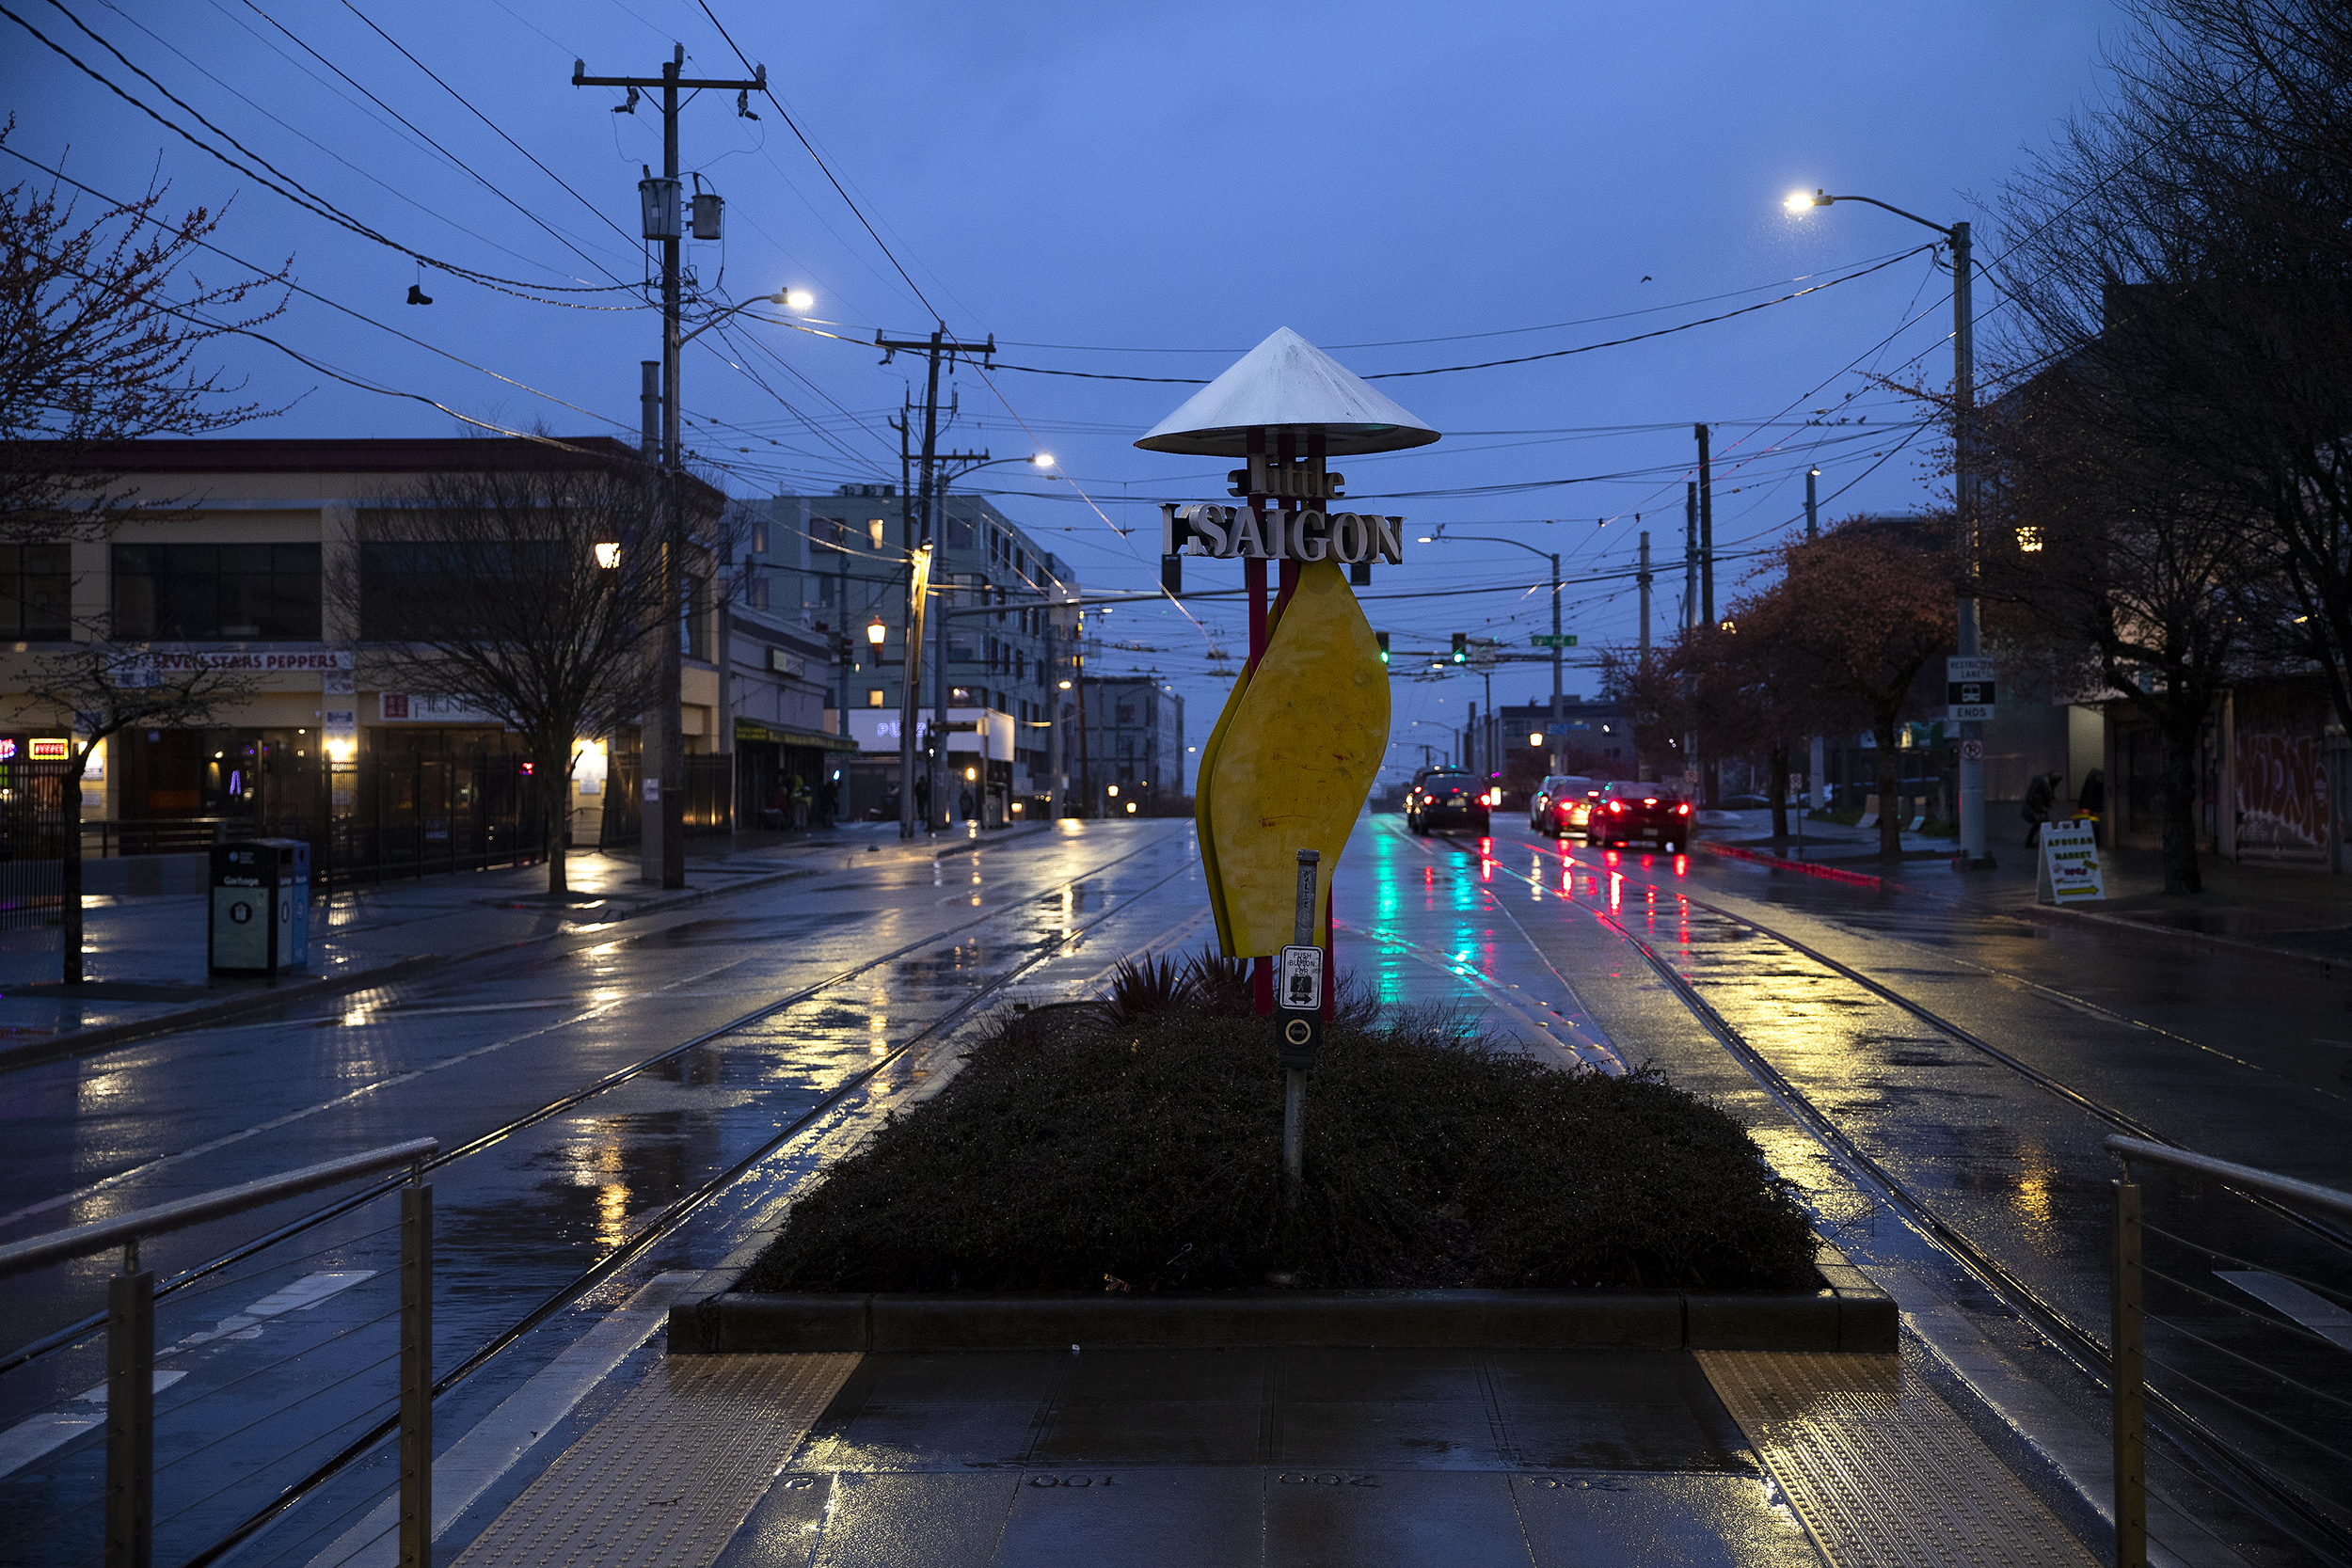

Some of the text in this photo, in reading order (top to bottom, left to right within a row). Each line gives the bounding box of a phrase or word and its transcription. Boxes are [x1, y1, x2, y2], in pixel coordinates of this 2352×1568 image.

[1248, 453, 1345, 499] little
[1188, 503, 1406, 565] SAIGON
[153, 655, 338, 669] SEVEN STARS PEPPERS
[1962, 670, 1980, 679] LANE
[1957, 707, 1987, 718] ENDS
[2047, 836, 2094, 847] AFRICAN
[2055, 850, 2092, 861] MARKET
[223, 876, 260, 887] Garbage
